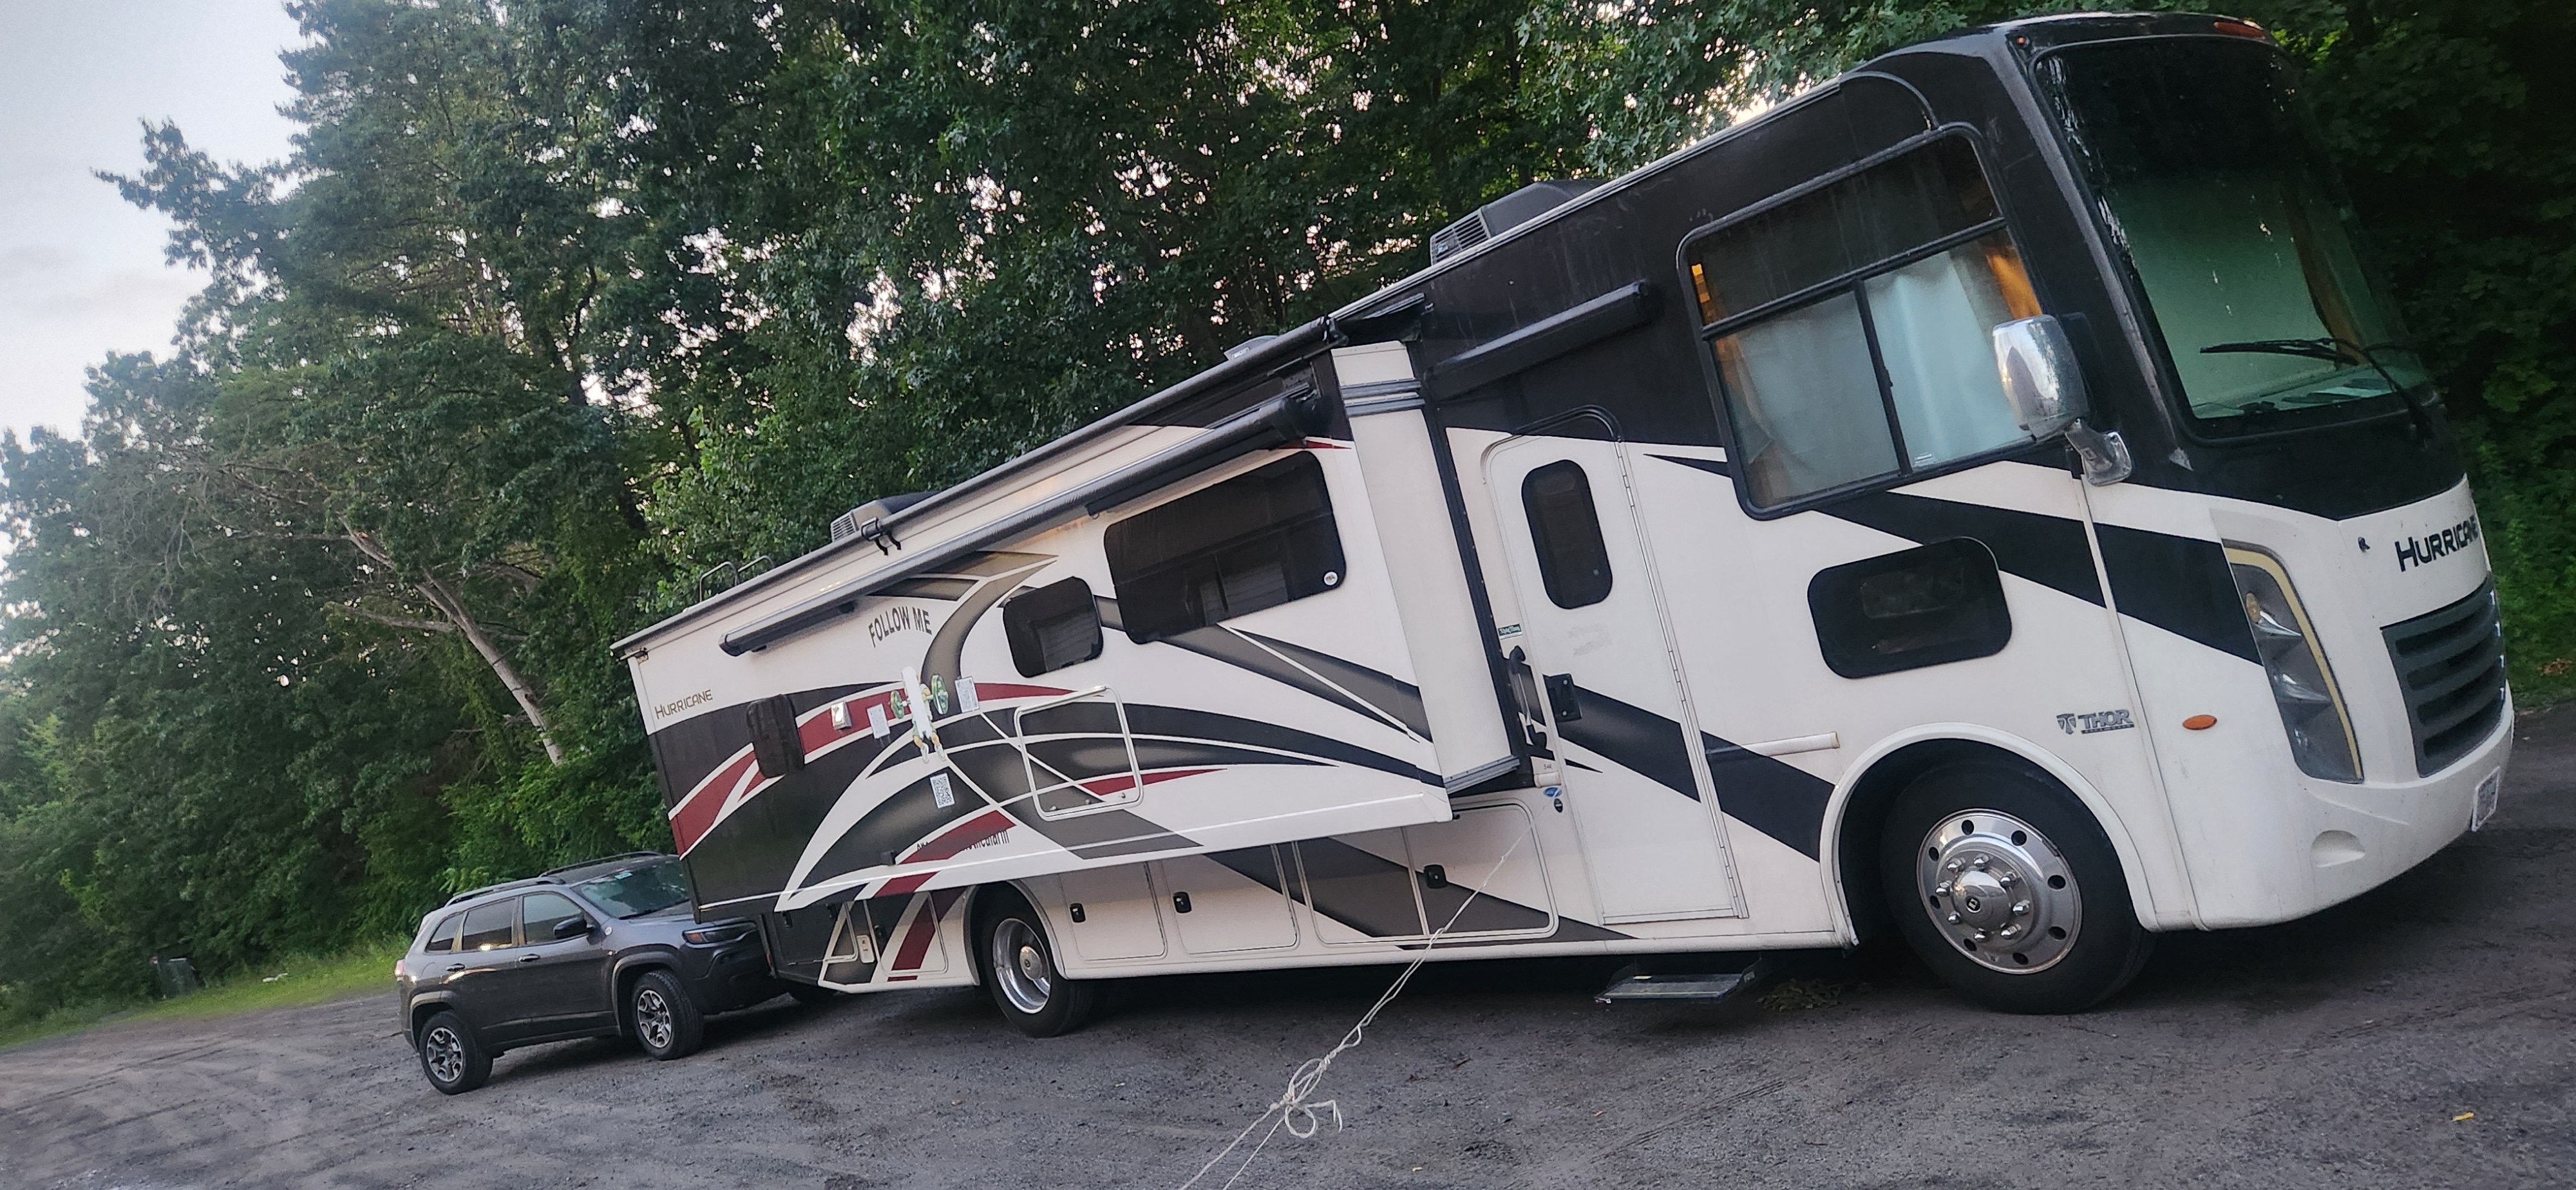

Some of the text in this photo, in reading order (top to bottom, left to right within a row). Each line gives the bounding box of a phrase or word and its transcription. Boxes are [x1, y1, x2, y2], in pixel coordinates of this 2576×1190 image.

[2394, 515, 2479, 572] HURRICANE
[868, 606, 933, 648] FOLLOW ME
[654, 689, 713, 720] HURRICANE
[2078, 709, 2134, 729] THOR
